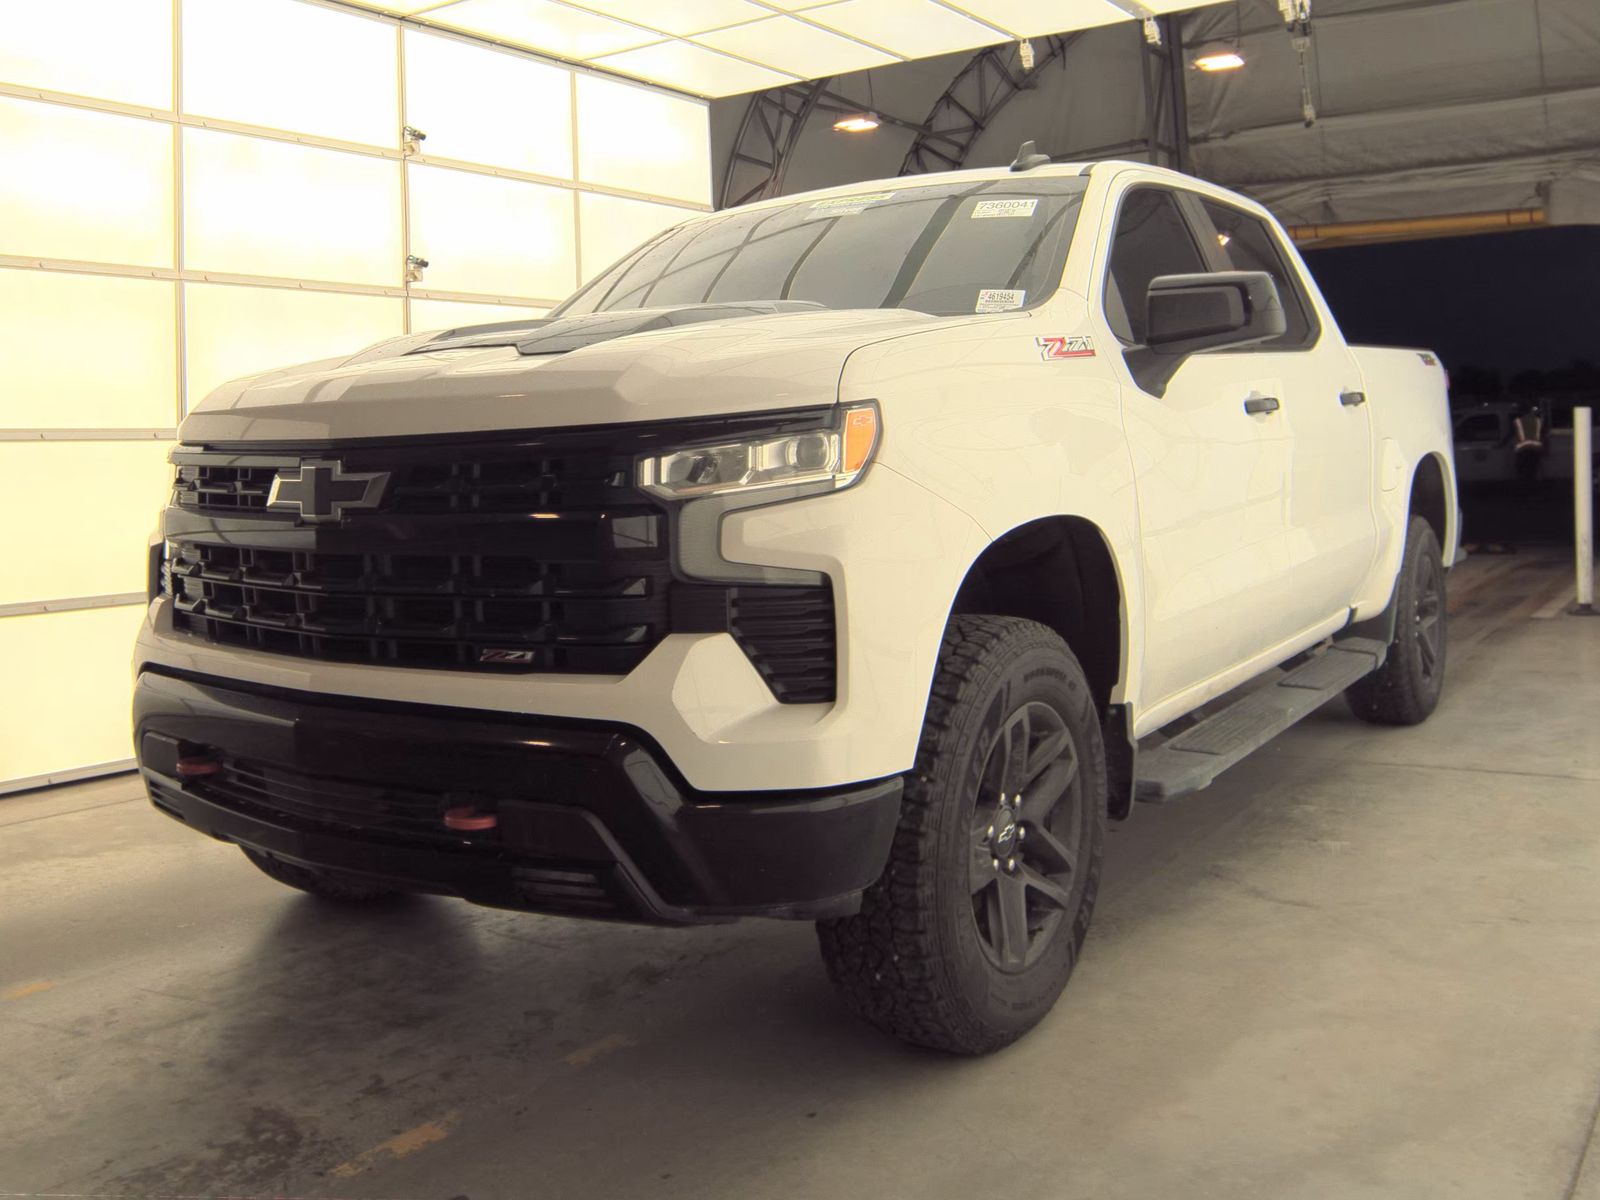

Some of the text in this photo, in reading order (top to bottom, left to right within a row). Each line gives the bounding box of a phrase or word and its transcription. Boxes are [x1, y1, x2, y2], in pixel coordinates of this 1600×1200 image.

[979, 201, 1036, 209] 7360041
[987, 292, 1015, 300] 4619454
[1035, 335, 1096, 361] Z71
